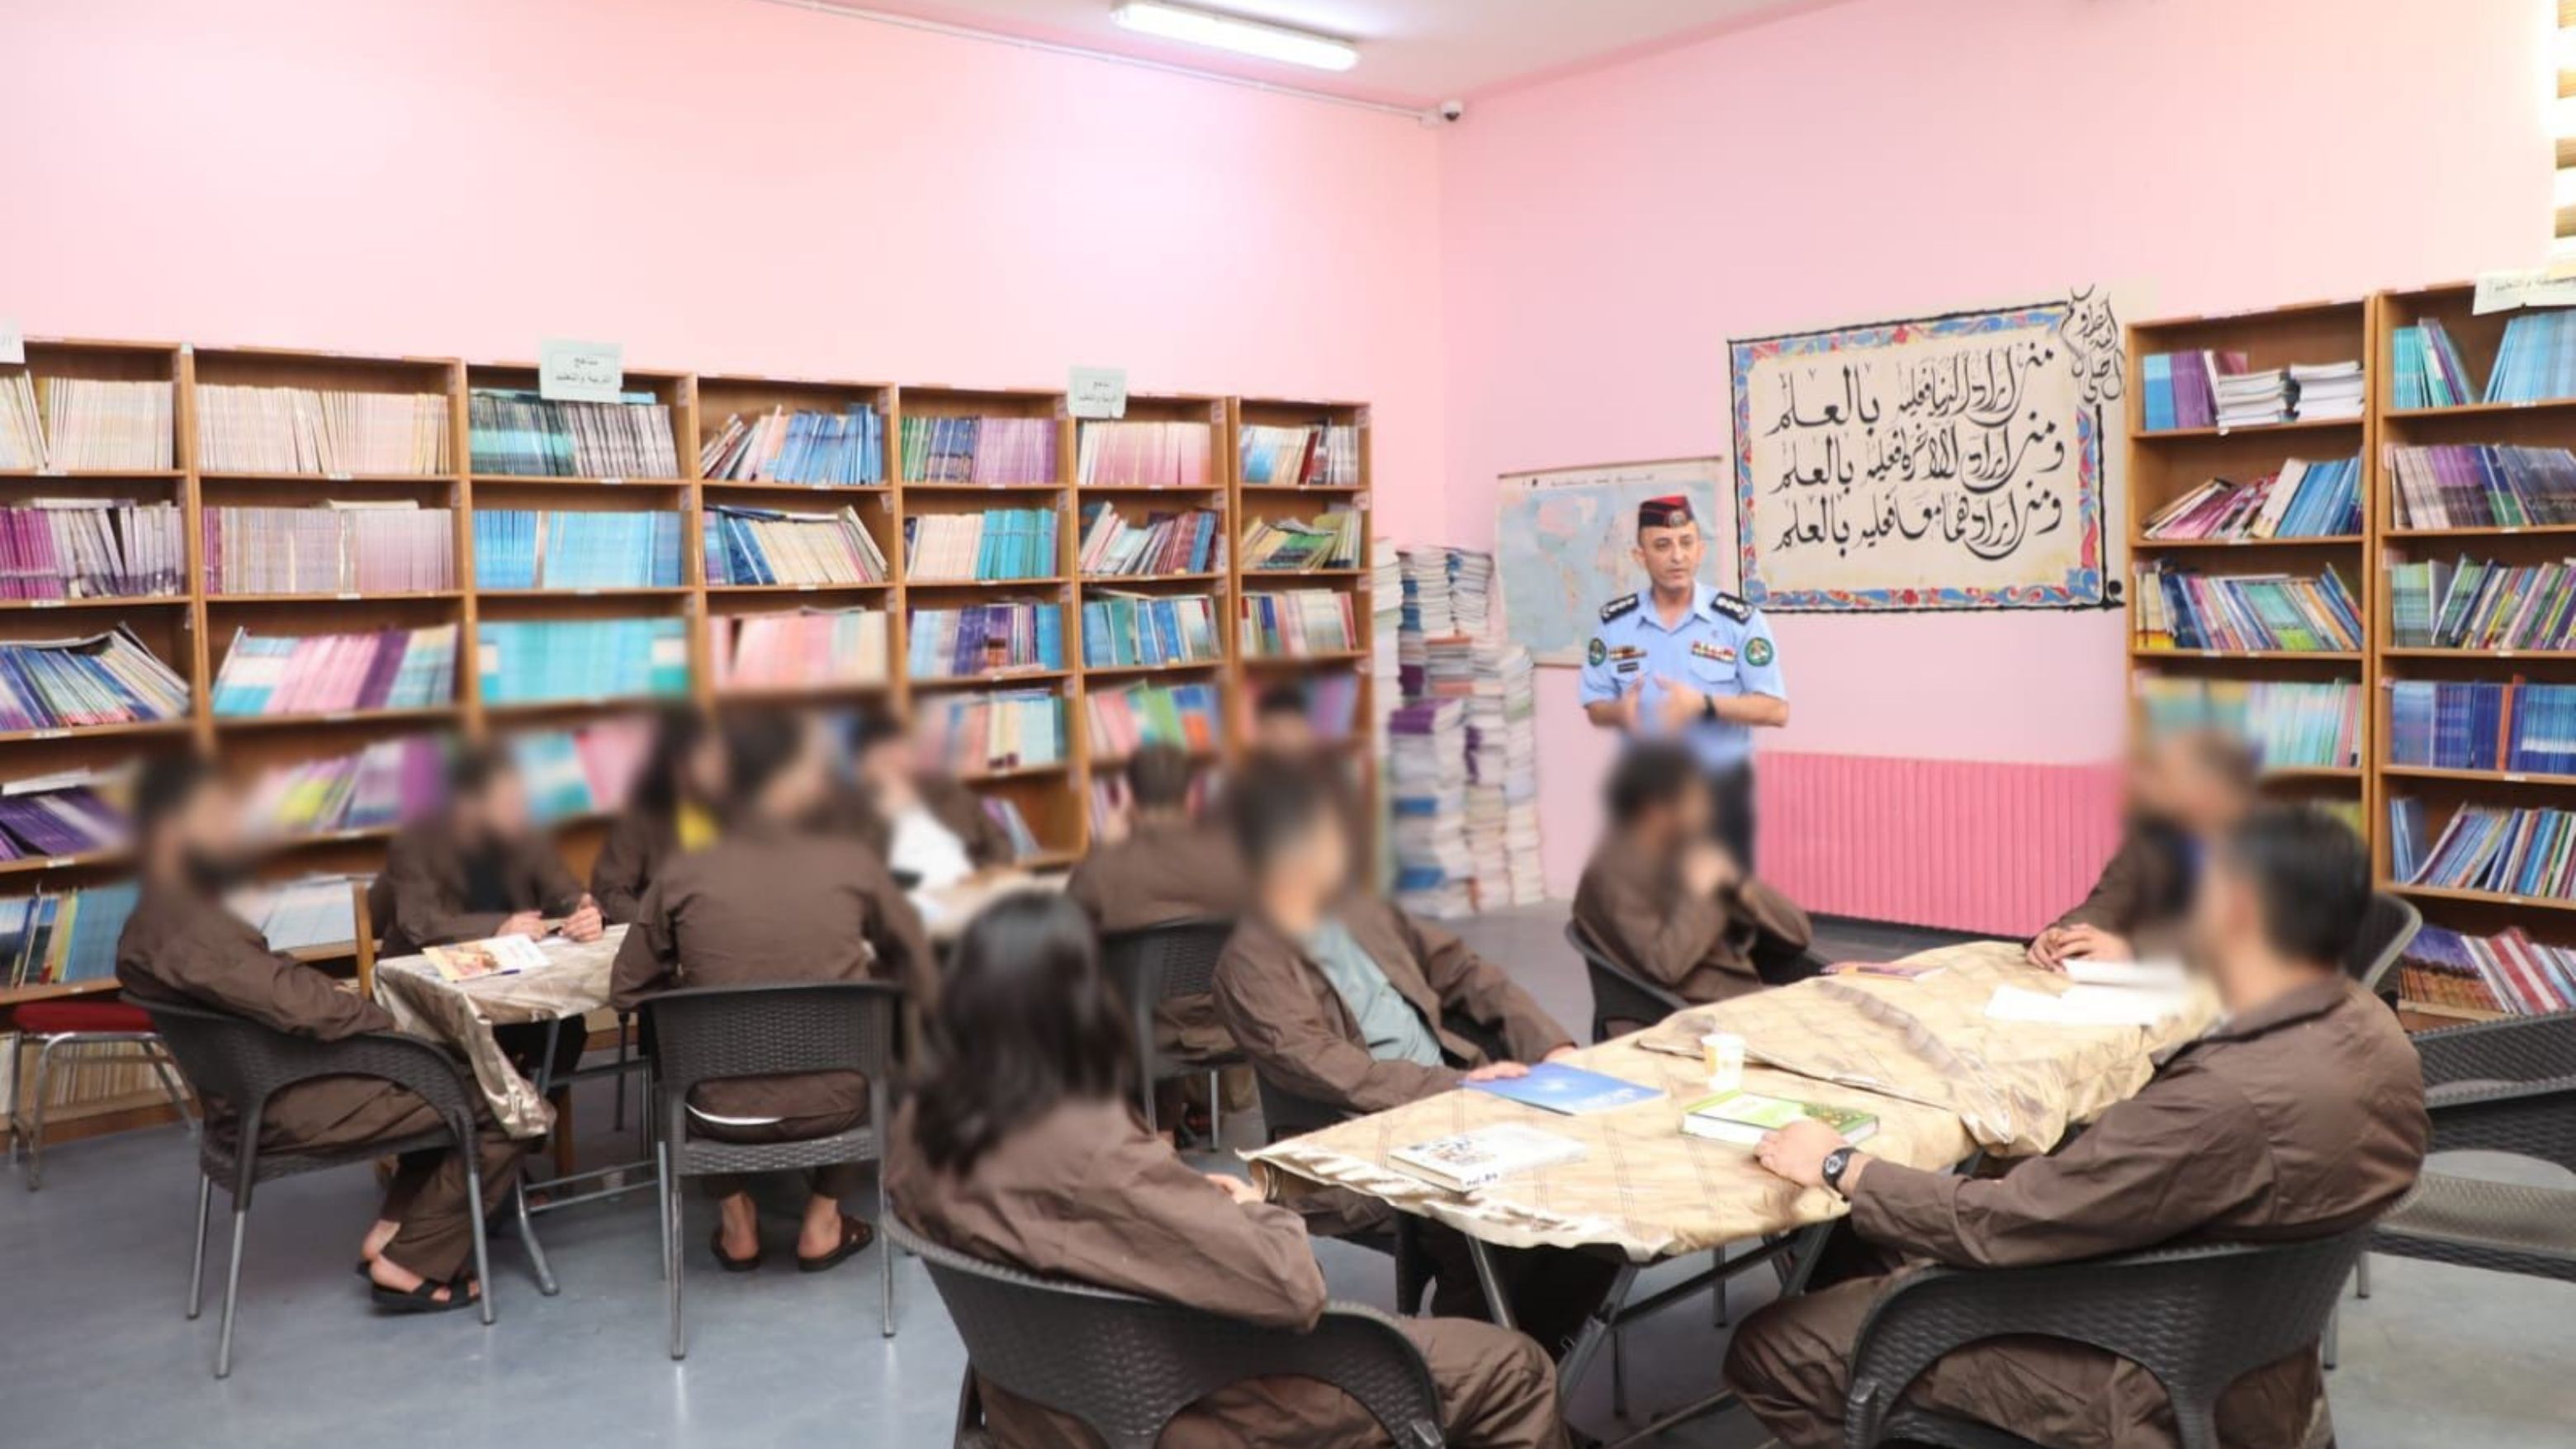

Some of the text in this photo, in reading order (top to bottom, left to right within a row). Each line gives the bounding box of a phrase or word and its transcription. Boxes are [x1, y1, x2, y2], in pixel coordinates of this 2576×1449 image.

[1764, 364, 1881, 438] بالعلم
[1890, 367, 1932, 423] فعليه
[1928, 349, 1971, 418] الدنيا
[1768, 433, 1854, 495] بالعلم
[1859, 429, 1903, 487] فعليه
[1772, 493, 1851, 558] بالعلم
[1852, 490, 1896, 550] فعليه
